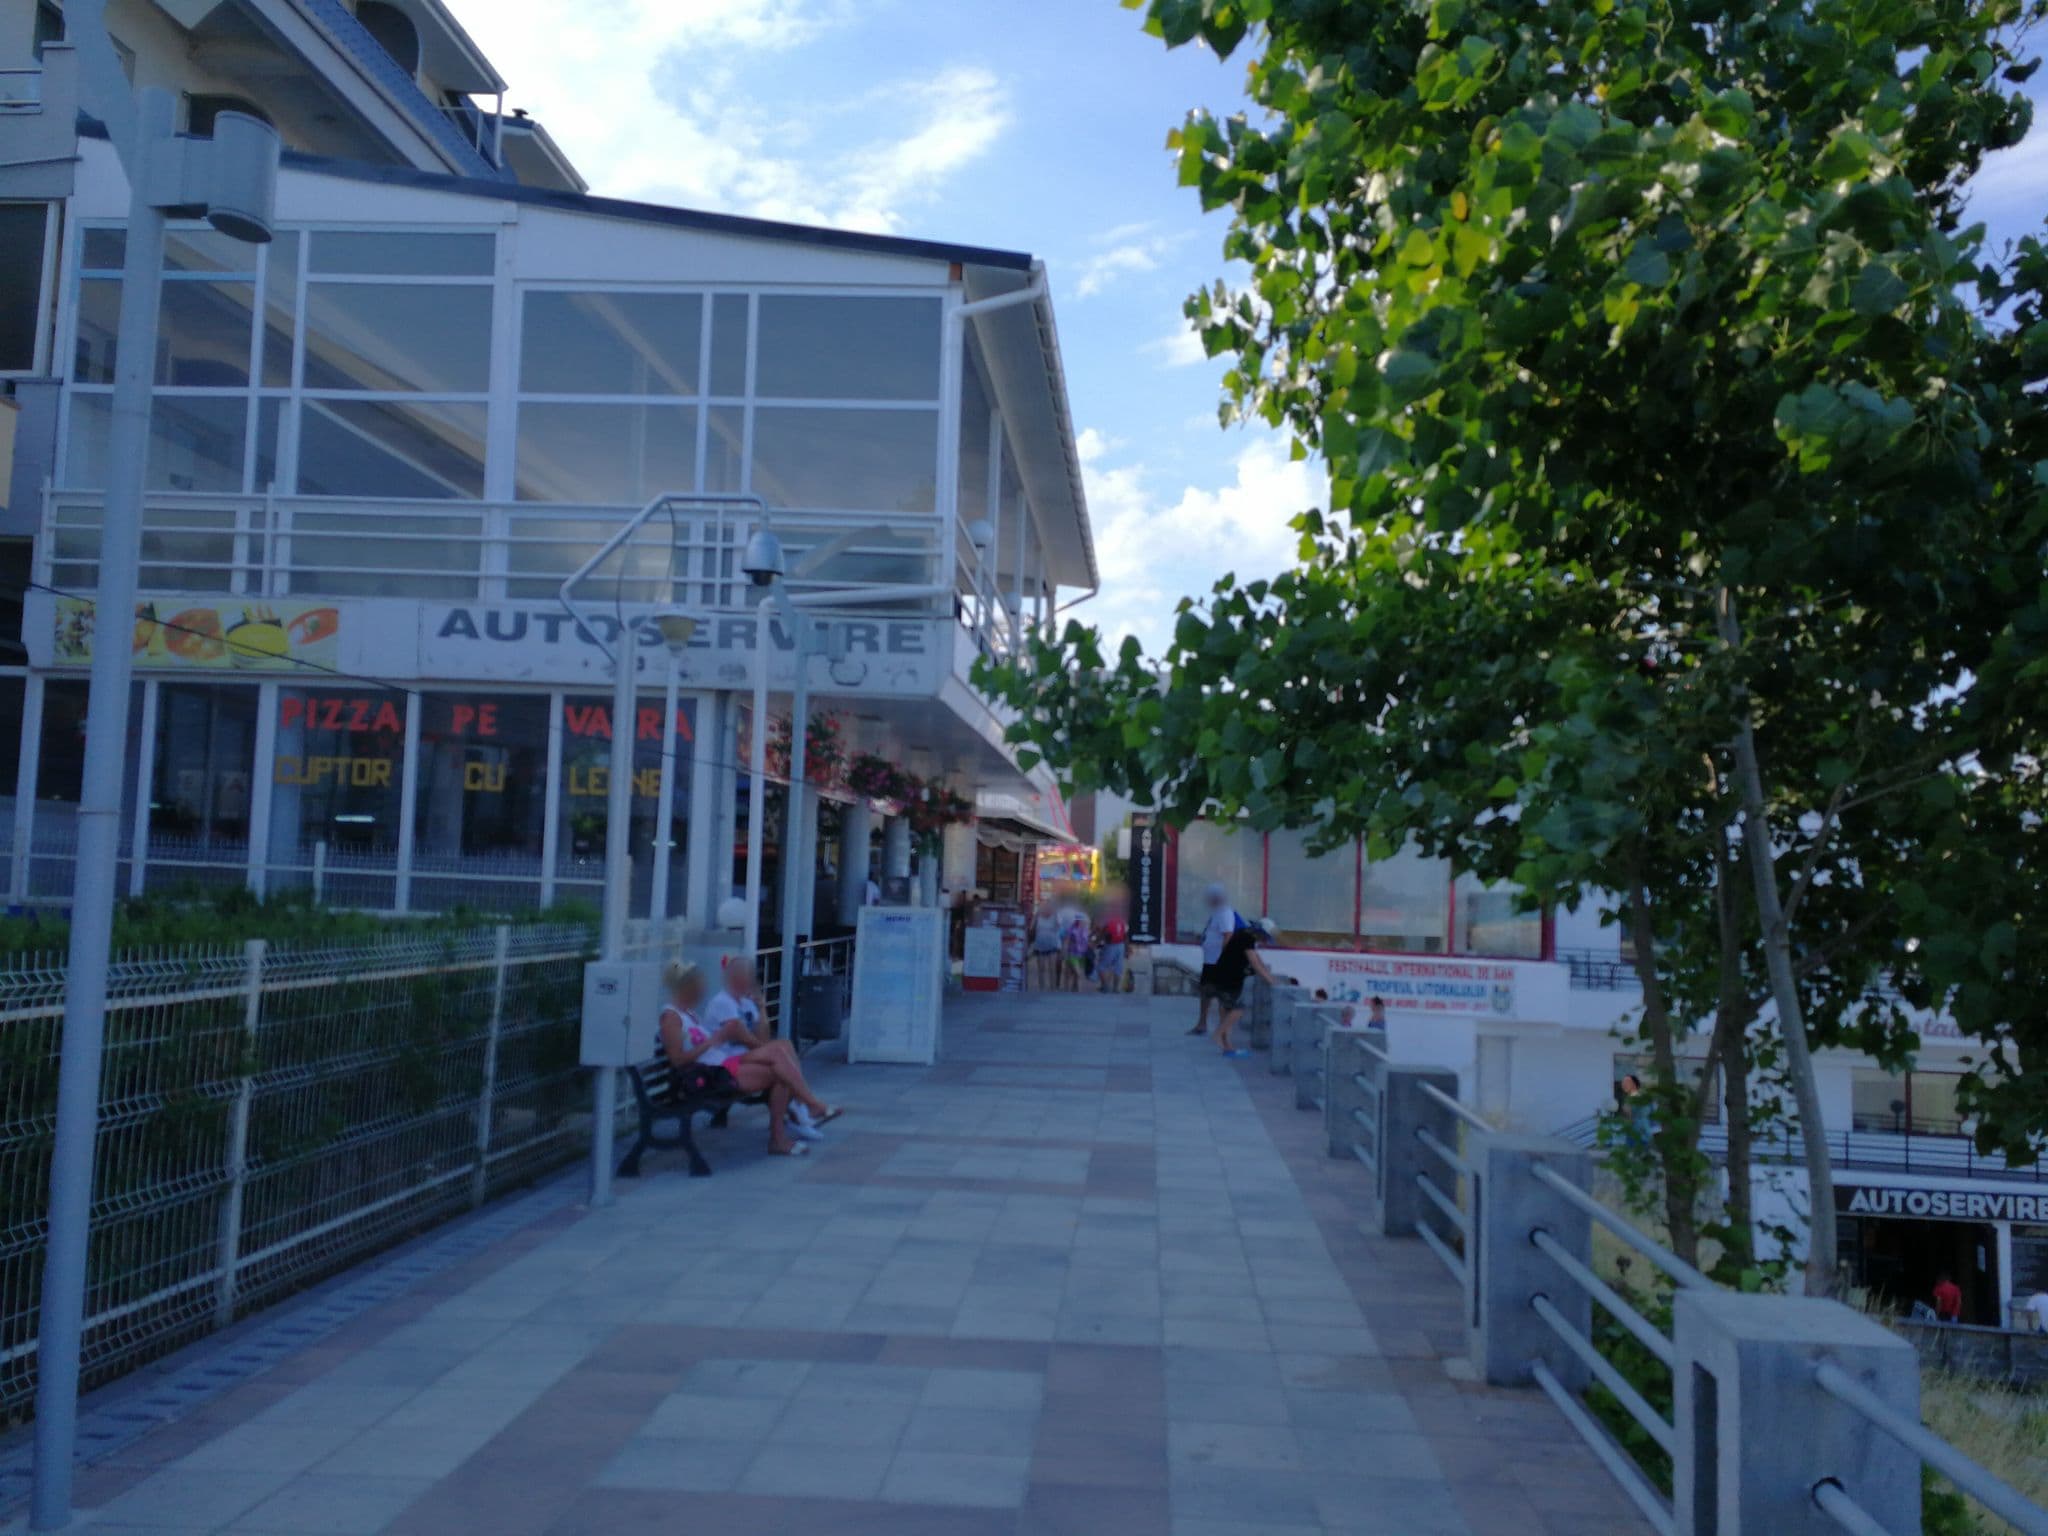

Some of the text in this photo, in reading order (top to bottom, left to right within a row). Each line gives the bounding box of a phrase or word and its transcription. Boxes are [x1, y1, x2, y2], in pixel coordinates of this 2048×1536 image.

[280, 696, 695, 742] PIZZA PE VARA
[273, 755, 662, 798] CUPTOR CU LENE
[1848, 1187, 2048, 1221] AUTOSERVIRE
